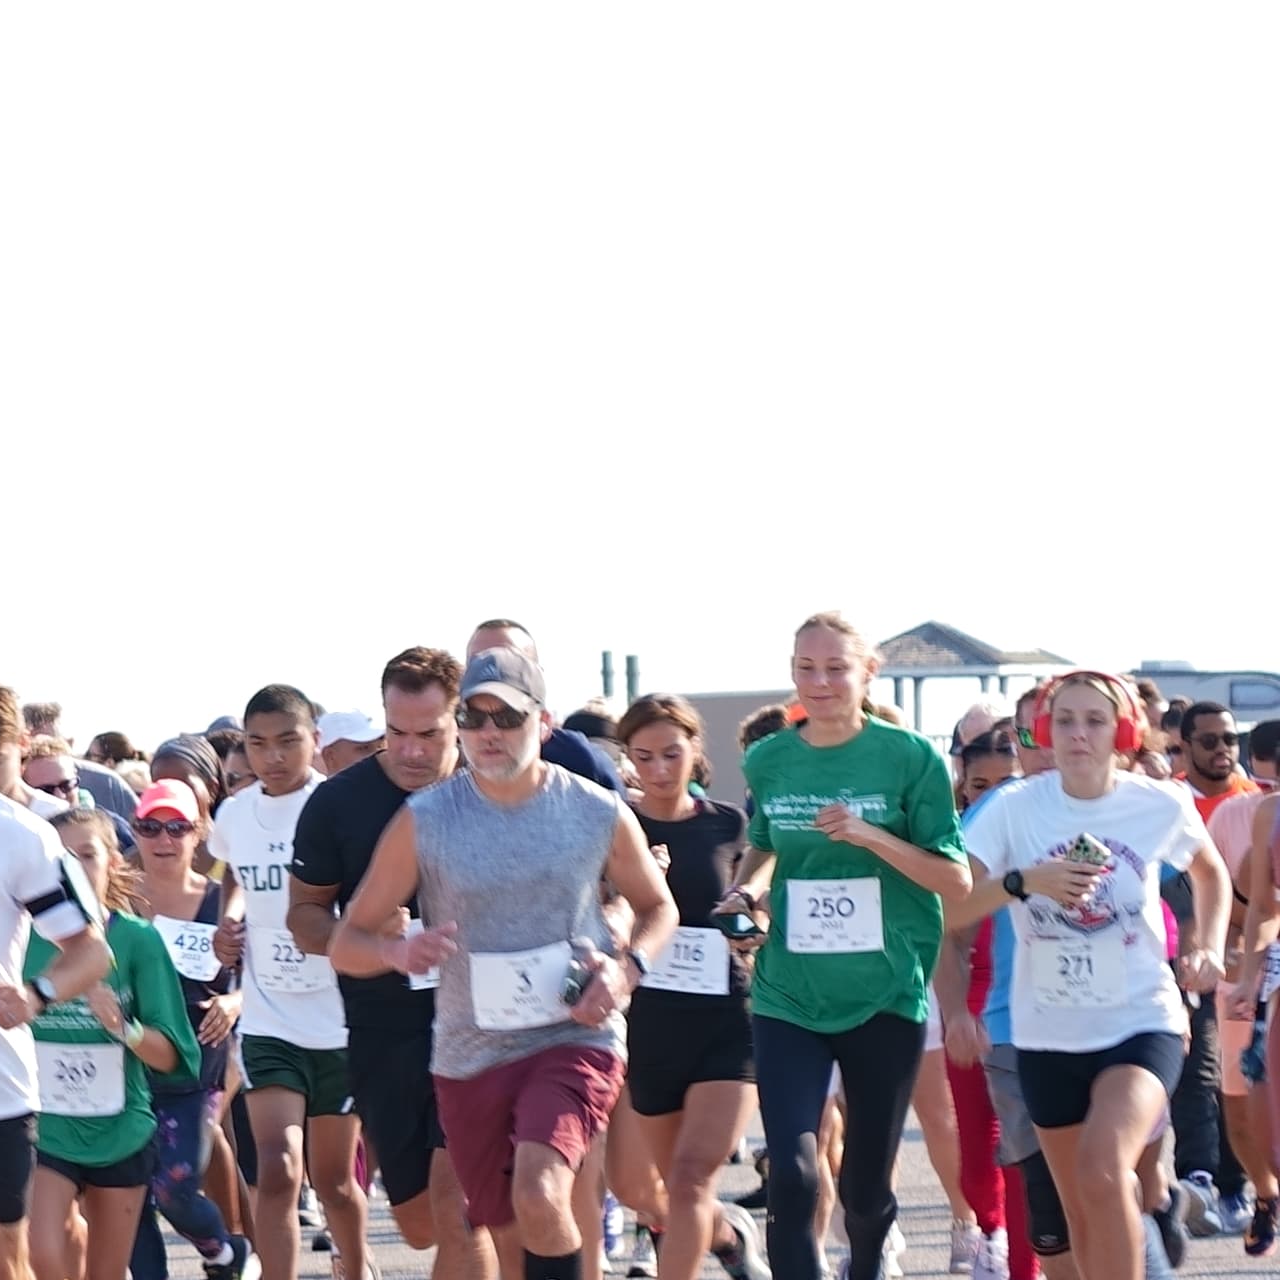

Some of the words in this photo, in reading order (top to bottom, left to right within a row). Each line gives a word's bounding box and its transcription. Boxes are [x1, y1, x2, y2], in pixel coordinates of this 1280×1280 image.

[807, 896, 855, 918] 250
[174, 934, 211, 953] 428
[1056, 954, 1093, 977] 271
